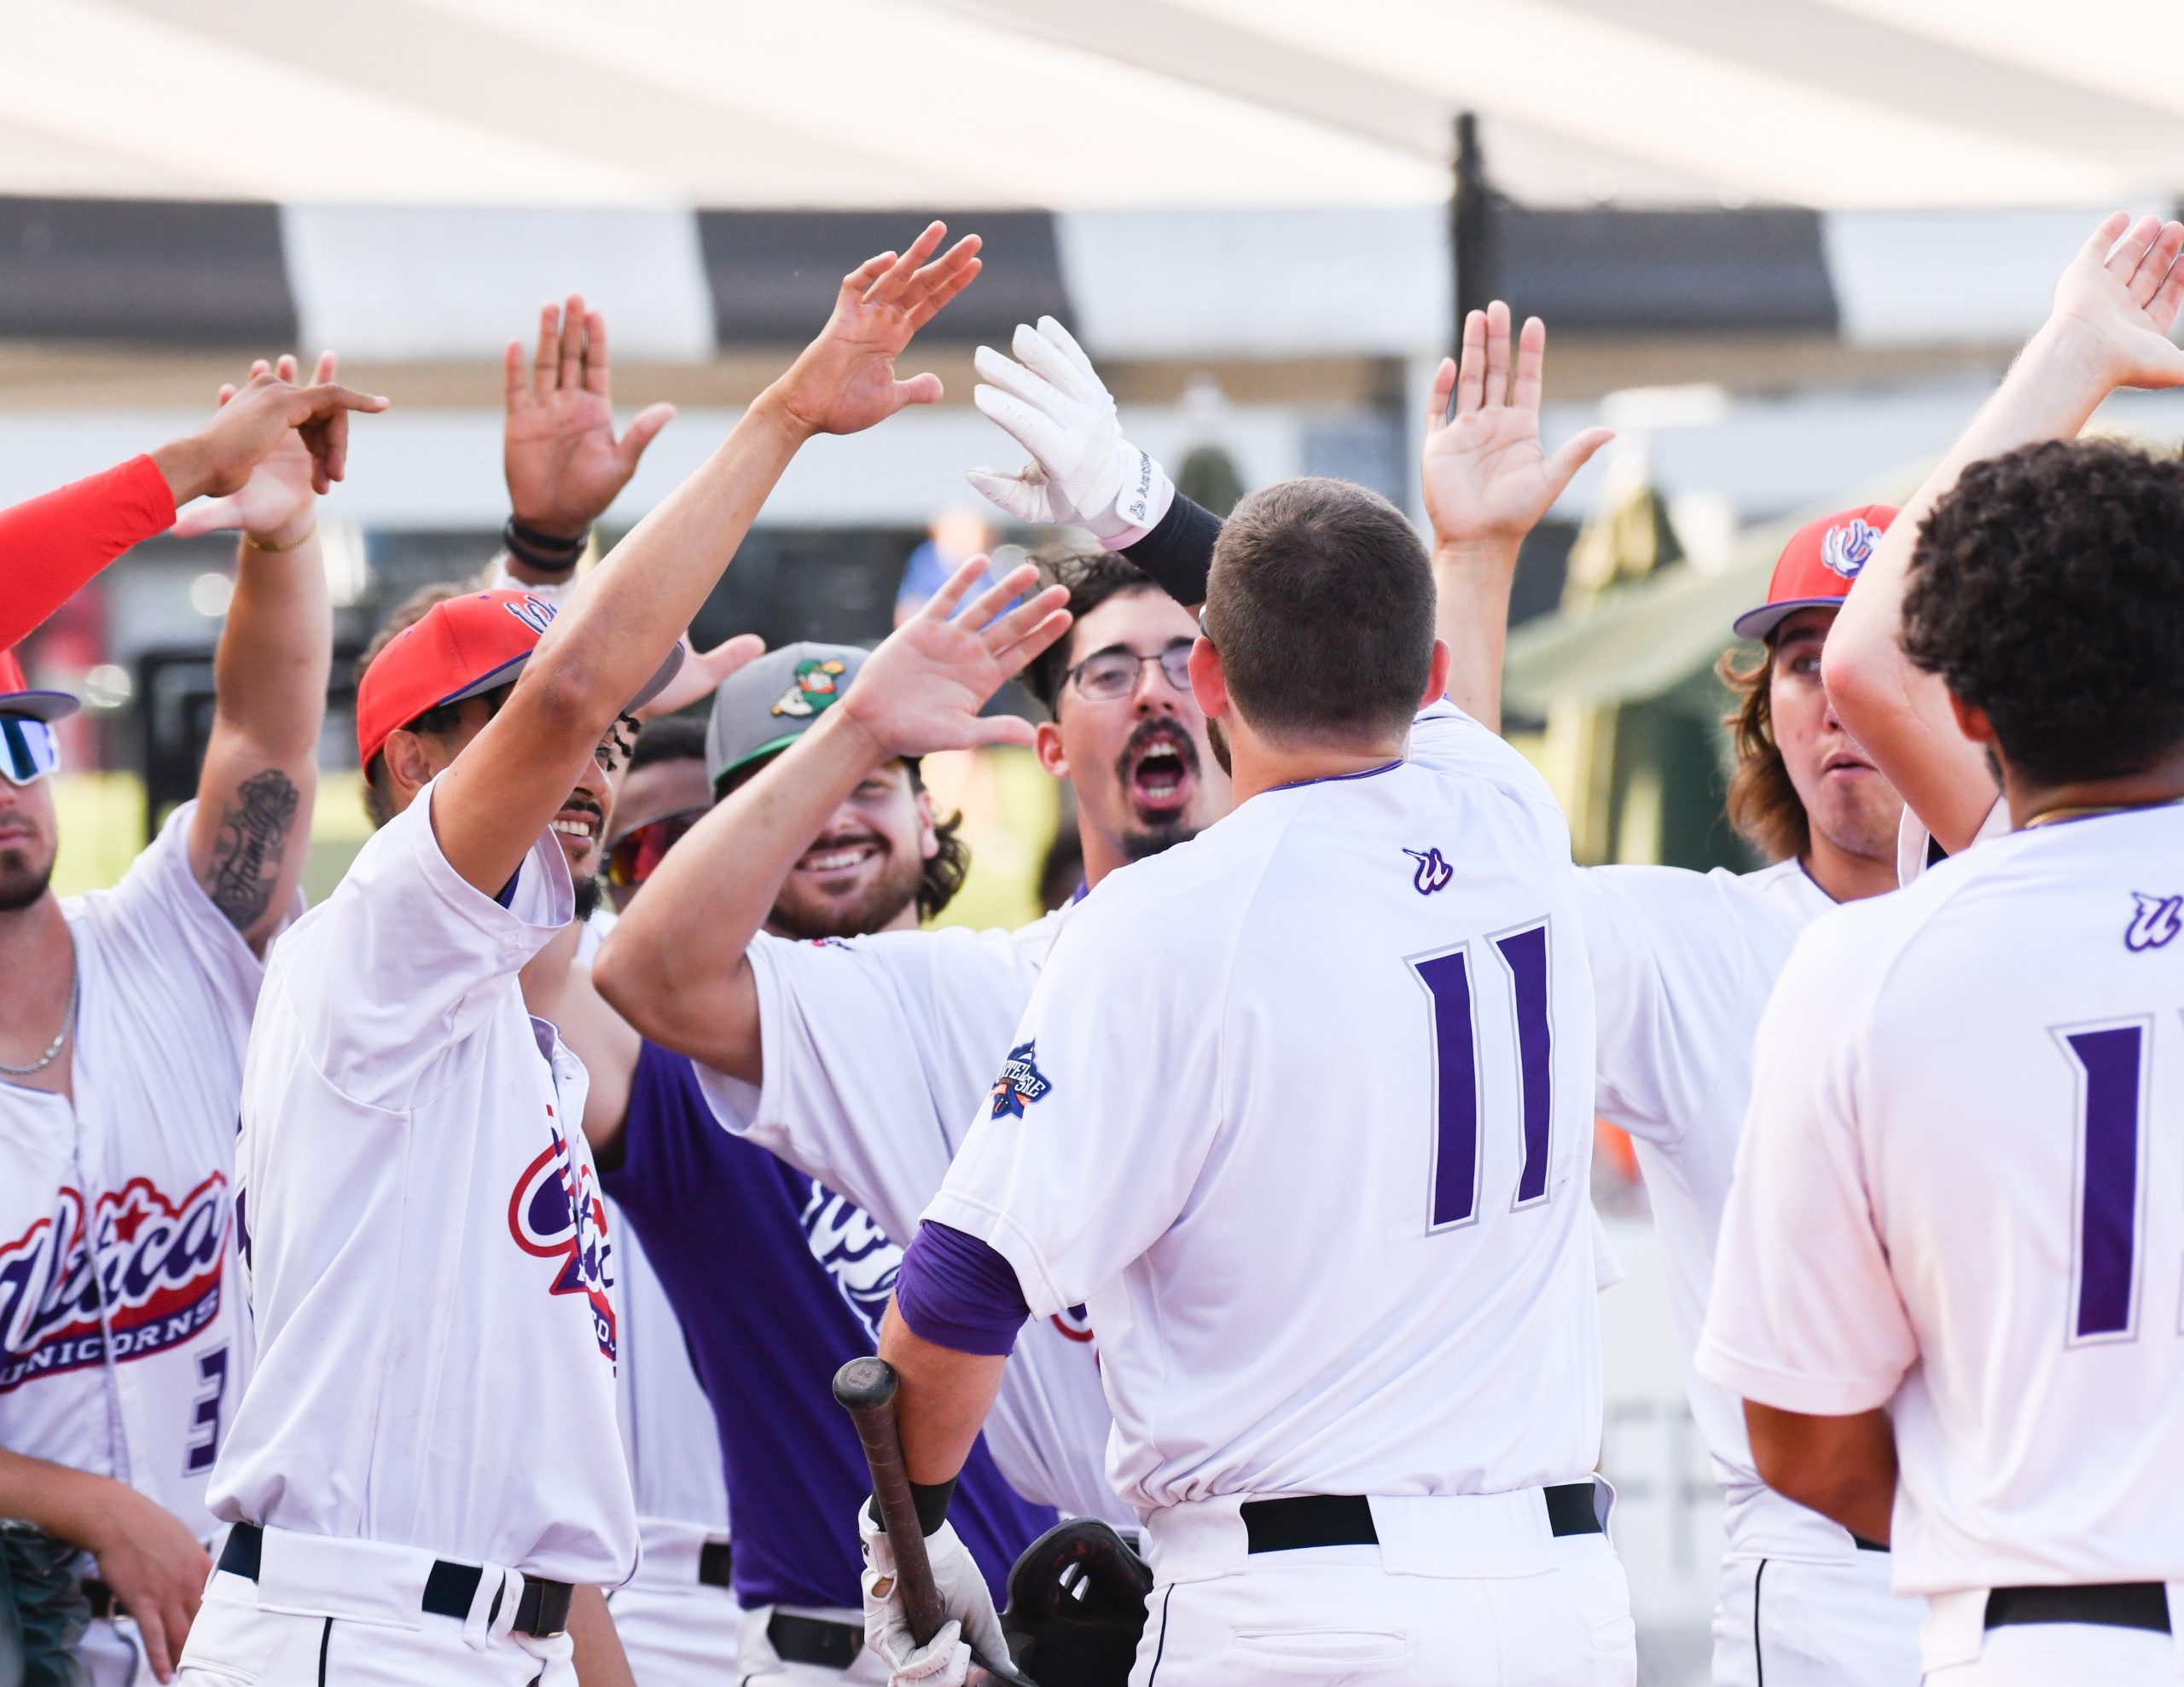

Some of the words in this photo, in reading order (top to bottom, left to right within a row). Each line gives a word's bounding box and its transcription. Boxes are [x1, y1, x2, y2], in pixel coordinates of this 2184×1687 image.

[1402, 914, 1554, 1238] 11
[2048, 1012, 2184, 1350] 1
[0, 1287, 219, 1385] UNICORNS
[183, 1337, 229, 1477] 3
